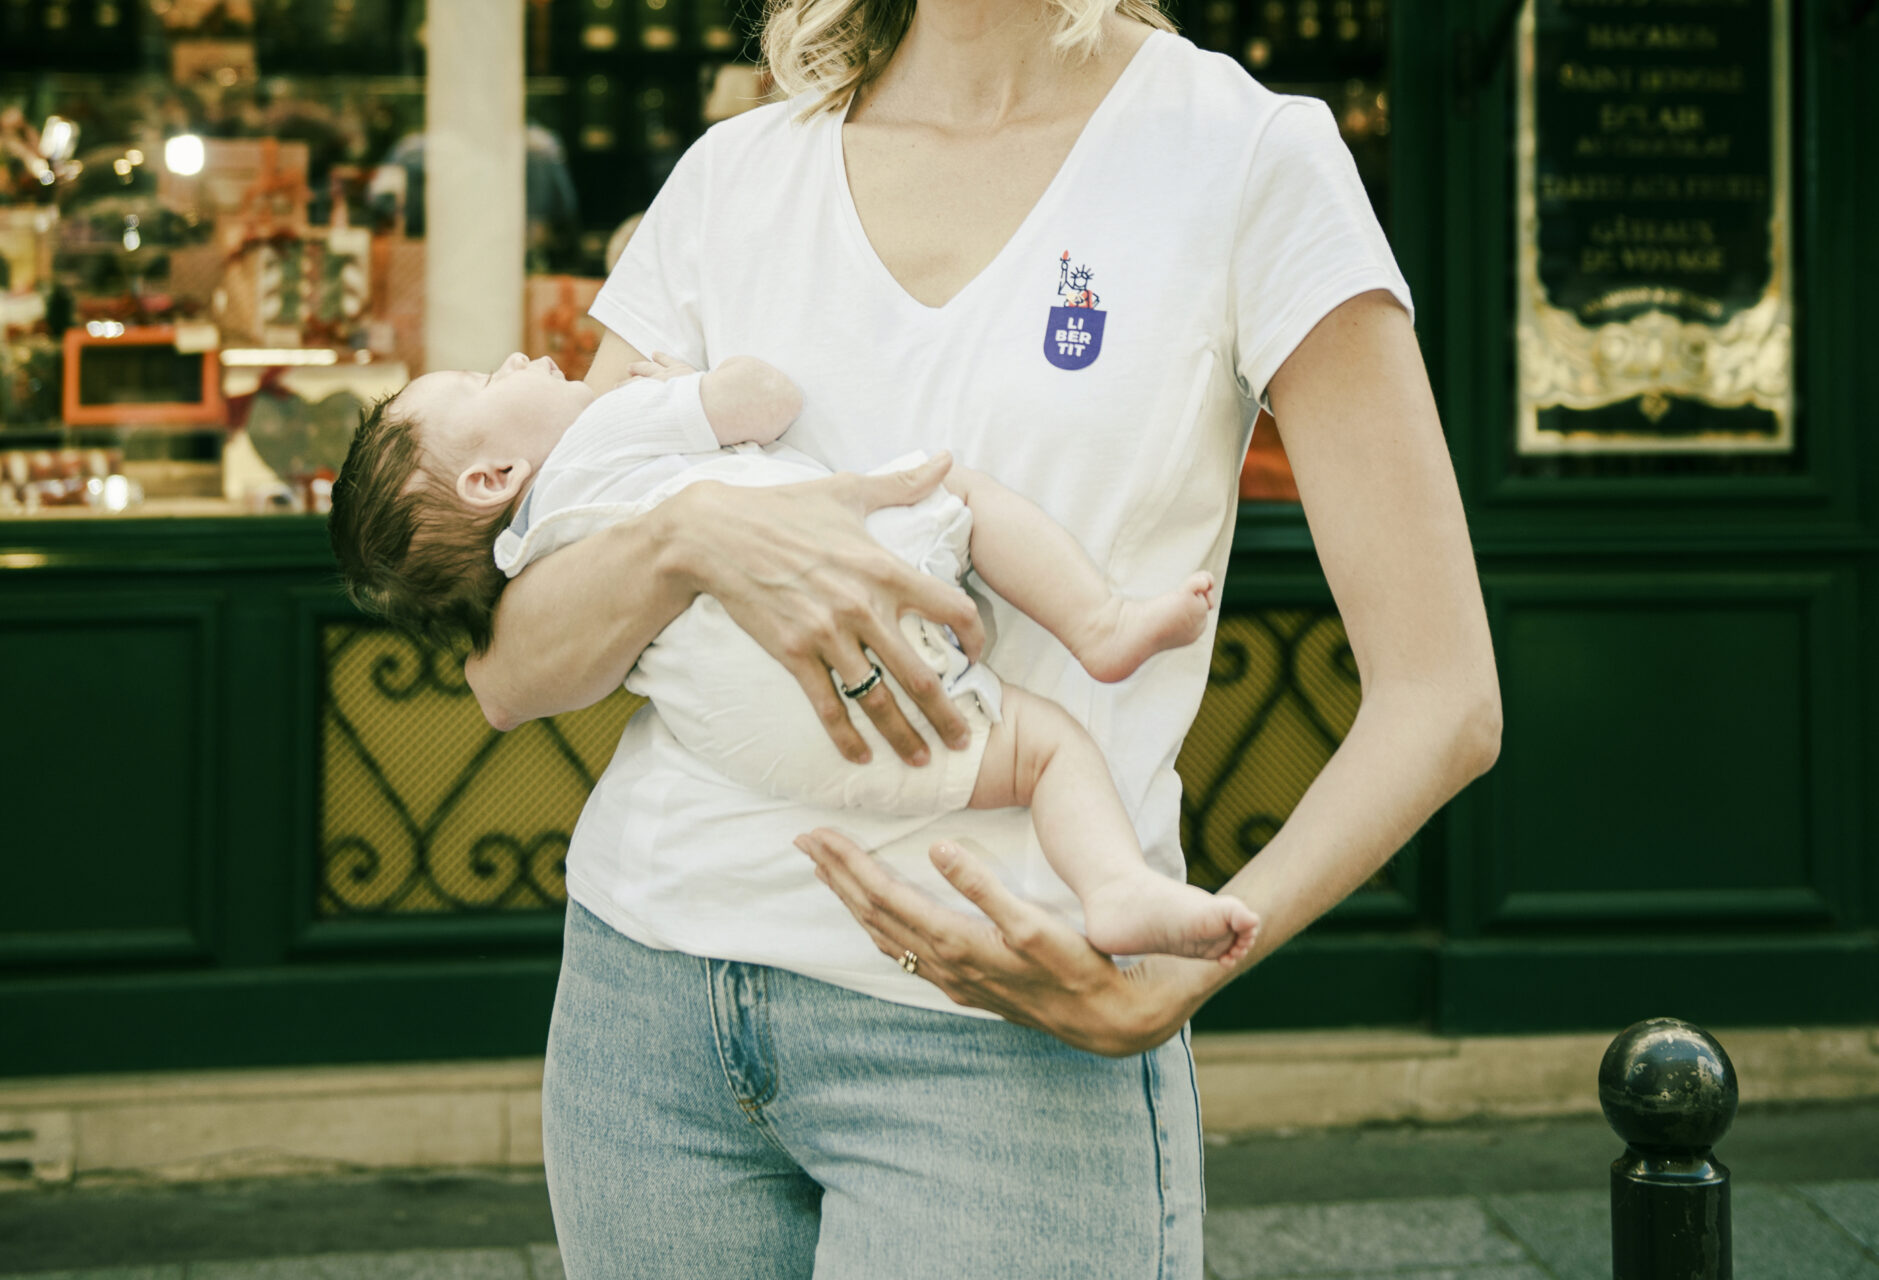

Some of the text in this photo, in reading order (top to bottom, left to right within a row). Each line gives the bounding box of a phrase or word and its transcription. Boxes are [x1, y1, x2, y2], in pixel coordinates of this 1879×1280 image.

[1067, 317, 1084, 330] LI
[1055, 329, 1092, 345] BER
[1057, 342, 1086, 357] TIT
